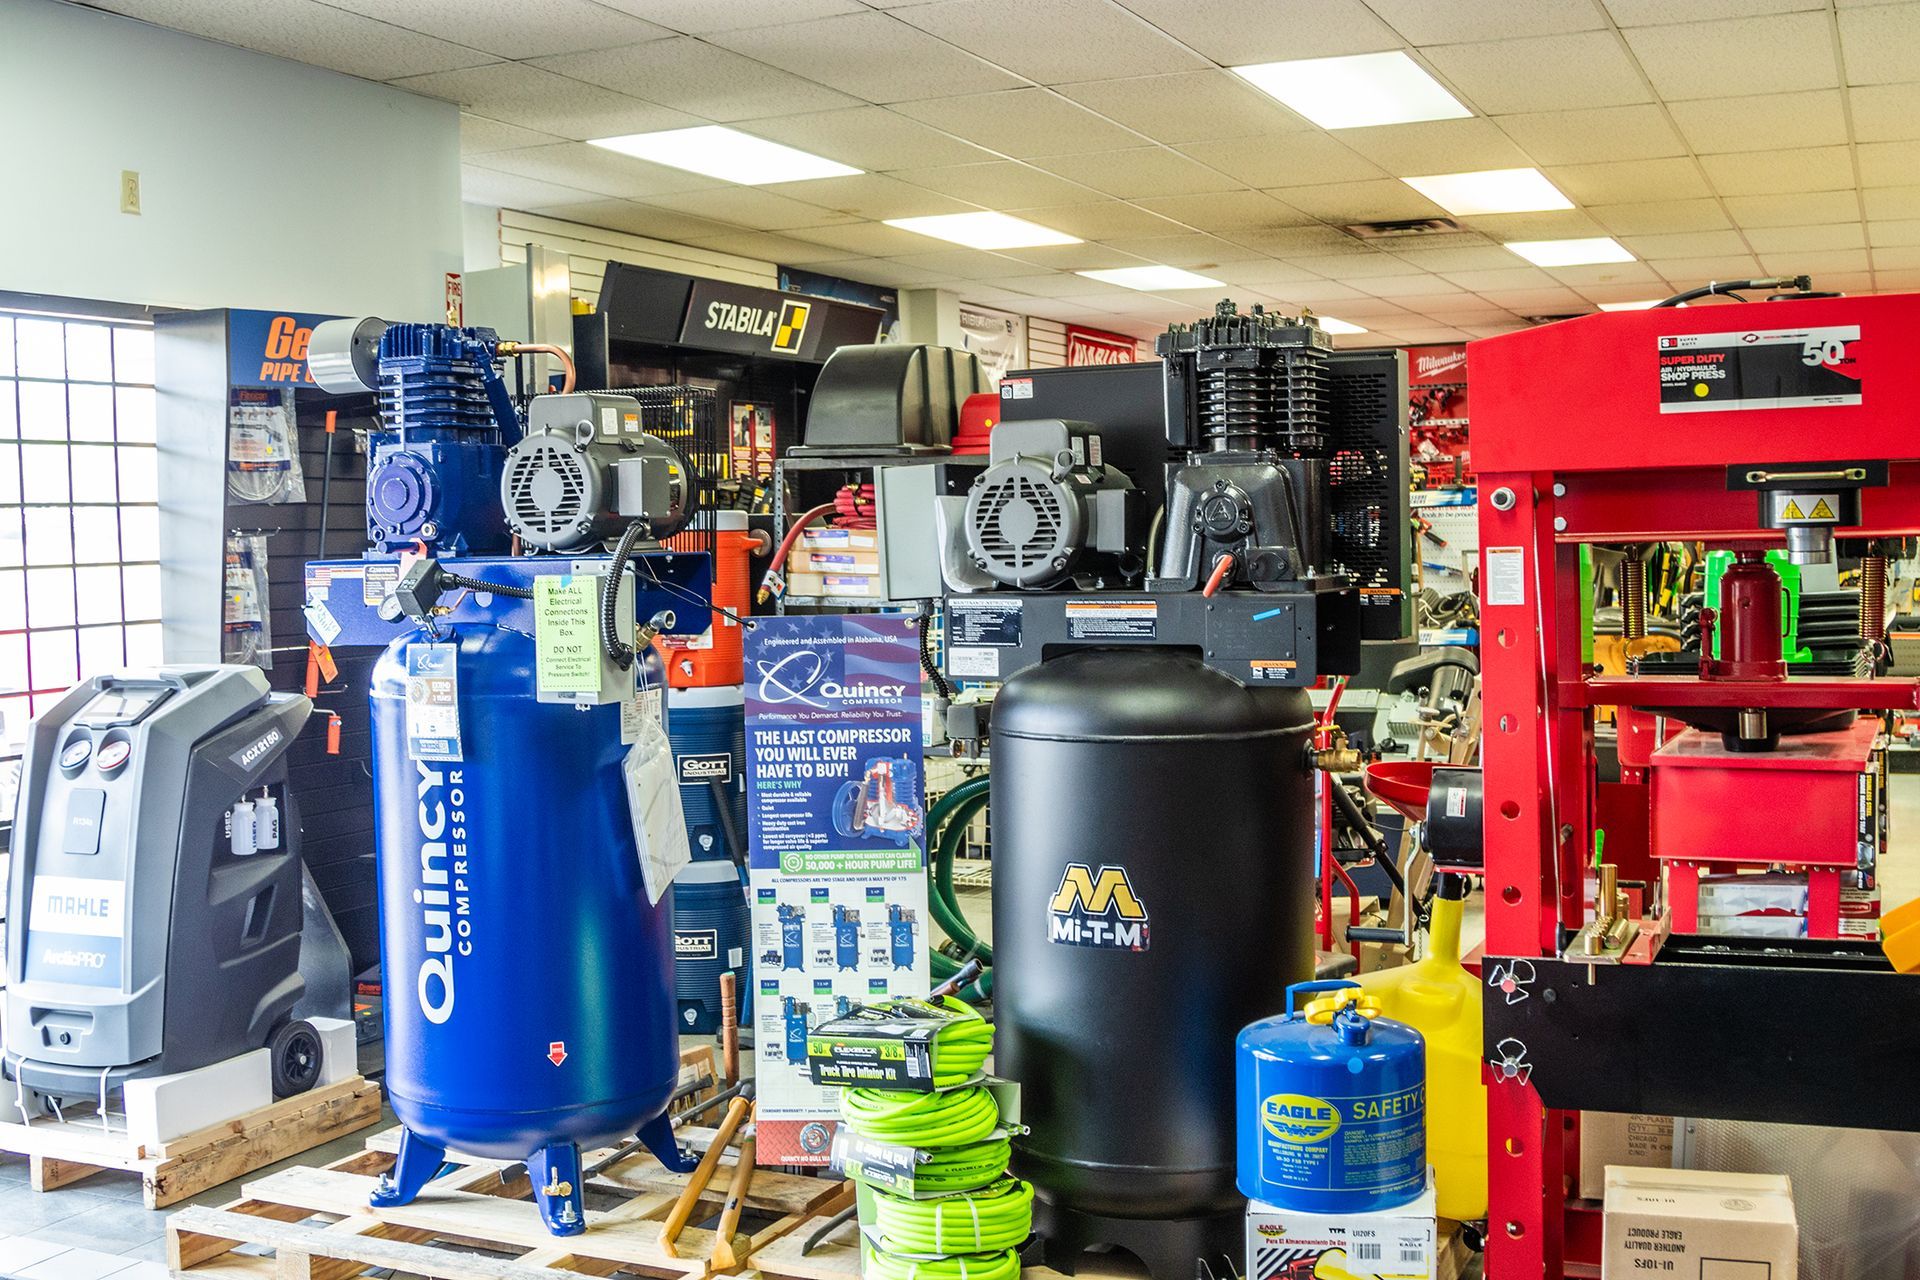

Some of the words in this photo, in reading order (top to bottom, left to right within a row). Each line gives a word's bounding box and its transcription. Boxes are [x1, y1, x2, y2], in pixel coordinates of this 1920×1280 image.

[704, 301, 774, 337] STABILA
[265, 316, 313, 360] Ge
[1801, 338, 1845, 366] 50
[1417, 353, 1466, 373] Milwaukee
[1661, 355, 1695, 365] SUPER
[1696, 354, 1725, 363] DUTY
[259, 362, 302, 382] PIPE
[1661, 372, 1690, 381] SHOP
[1692, 370, 1726, 380] PRESS
[550, 597, 581, 605] Electrical
[544, 608, 588, 616] Connections
[571, 618, 585, 626] This
[764, 638, 799, 646] Engineered
[800, 637, 812, 645] and
[813, 637, 846, 645] Assembled
[855, 636, 883, 644] Alabama,
[885, 635, 897, 643] USA
[566, 645, 582, 653] NOT
[758, 712, 797, 720] Performance
[798, 712, 810, 720] You
[841, 711, 870, 720] Reliability
[755, 731, 781, 745] THE
[782, 730, 815, 745] LAST
[817, 728, 911, 744] COMPRESSOR
[241, 731, 279, 766] ACX2150
[755, 747, 785, 762] YOU
[787, 747, 821, 761] WILL
[823, 746, 857, 760] EVER
[683, 759, 727, 770] GOTT
[756, 764, 793, 778] HAVE
[796, 763, 814, 778] TO
[816, 763, 849, 777] BUY!
[756, 781, 783, 789] HERE'S
[784, 781, 802, 789] WHY
[224, 811, 232, 839] USED
[450, 770, 472, 956] COMPRESSOR
[805, 861, 835, 870] 50,000
[845, 860, 870, 869] HOUR
[871, 860, 896, 869] PUMP
[897, 860, 916, 868] LIFE!
[47, 895, 109, 917] MAHLE
[1053, 917, 1140, 946] Mi-T-M
[813, 1043, 823, 1054] 50
[885, 1046, 898, 1058] 3/8
[819, 1064, 840, 1077] Truck
[841, 1065, 856, 1078] Tire
[857, 1065, 884, 1080] Inflator
[885, 1067, 897, 1080] Kit
[1266, 1101, 1331, 1120] EAGLE
[1353, 1091, 1418, 1120] SAFETY
[1267, 1139, 1303, 1151] MANUFACTURING
[1628, 1228, 1659, 1238] PRODUCT
[1661, 1231, 1682, 1240] EAGLE
[1624, 1241, 1652, 1250] QUALITY
[1652, 1242, 1685, 1252] ANOTHER
[1634, 1258, 1673, 1270] UI-10FS
